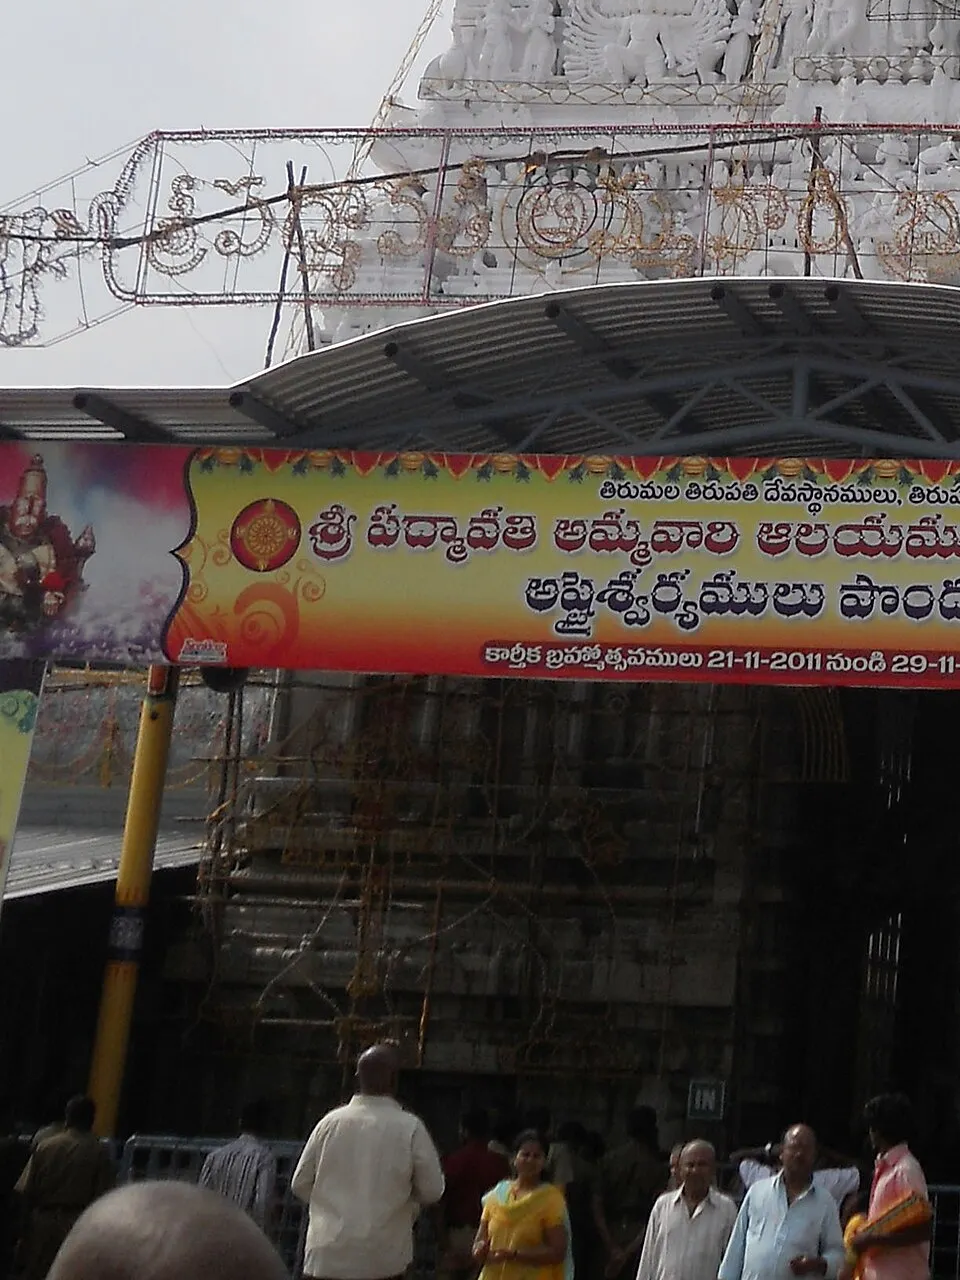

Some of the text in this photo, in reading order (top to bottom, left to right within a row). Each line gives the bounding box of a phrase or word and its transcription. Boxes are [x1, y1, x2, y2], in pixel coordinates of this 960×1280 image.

[600, 480, 679, 501] తిరుమల
[685, 480, 758, 501] తిరుపతి
[764, 477, 902, 515] దేవస్థానములు,
[308, 504, 357, 561] శ్రీ
[367, 504, 538, 563] పద్మావతి
[553, 509, 740, 567] అమ్మవారి
[524, 569, 826, 637] అష్టైశ్వర్యములు
[484, 645, 541, 669] కార్తీక
[545, 647, 703, 672] బ్రహ్మోత్సవములు
[707, 649, 821, 672] 21-11-2011
[826, 652, 887, 674] నుండి
